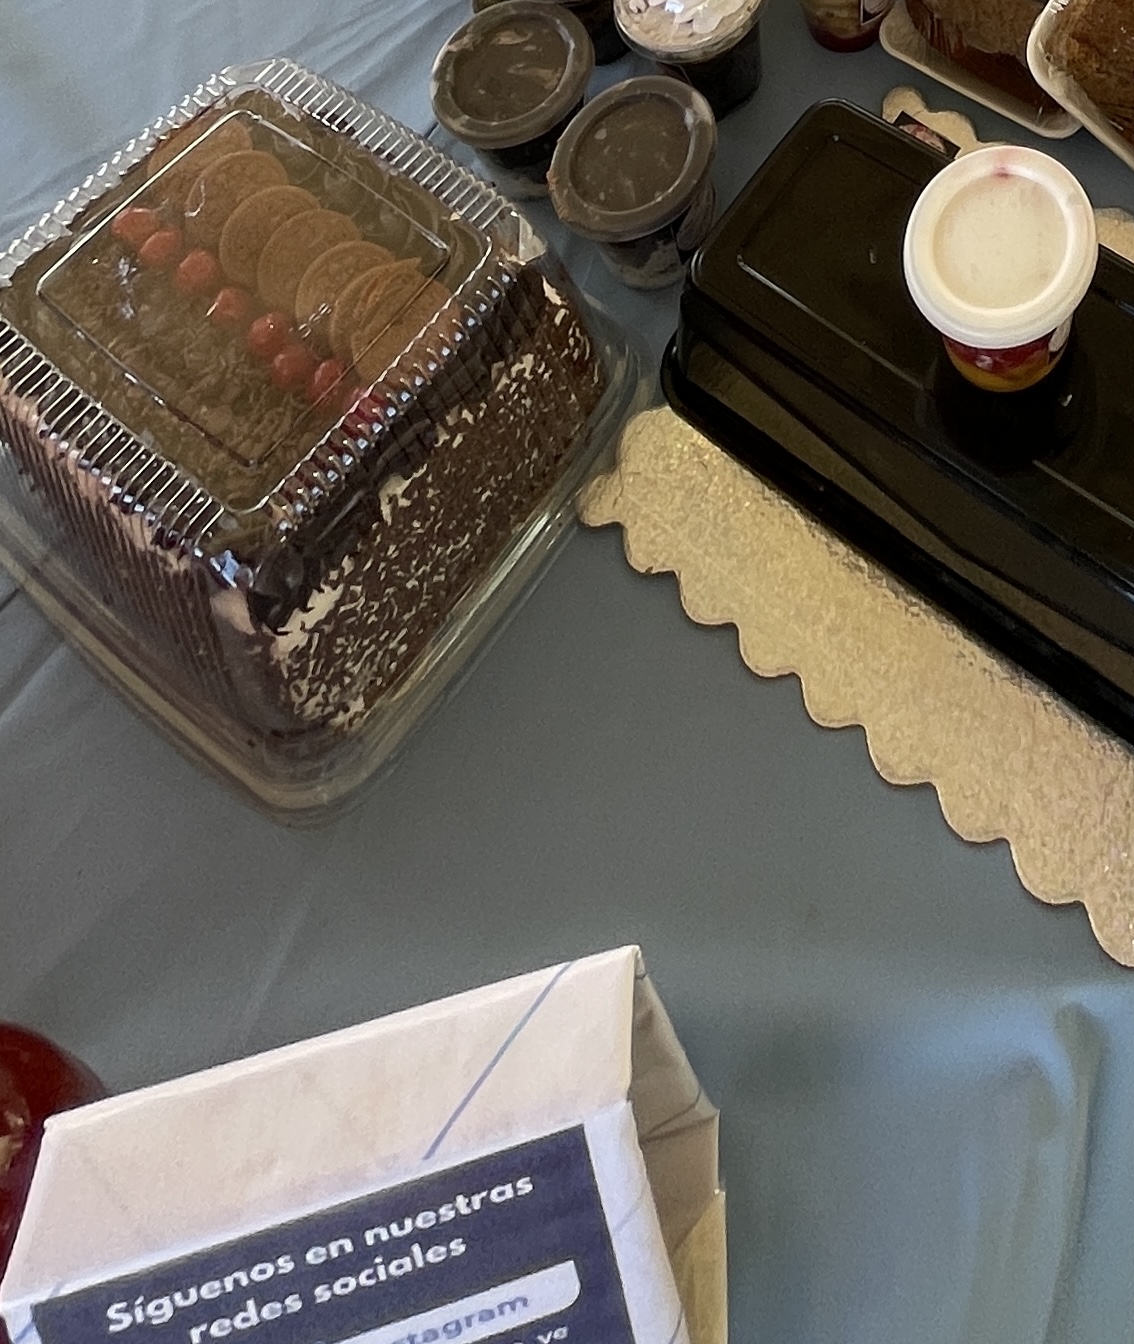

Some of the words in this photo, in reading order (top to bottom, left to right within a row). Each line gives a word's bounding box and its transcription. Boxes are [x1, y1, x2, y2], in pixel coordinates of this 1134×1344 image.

[106, 1254, 295, 1334] Síguenos
[304, 1236, 354, 1265] en
[363, 1176, 535, 1246] nuestras
[188, 1293, 303, 1344] redes
[313, 1237, 467, 1304] sociales
[393, 1295, 529, 1344] tagram
